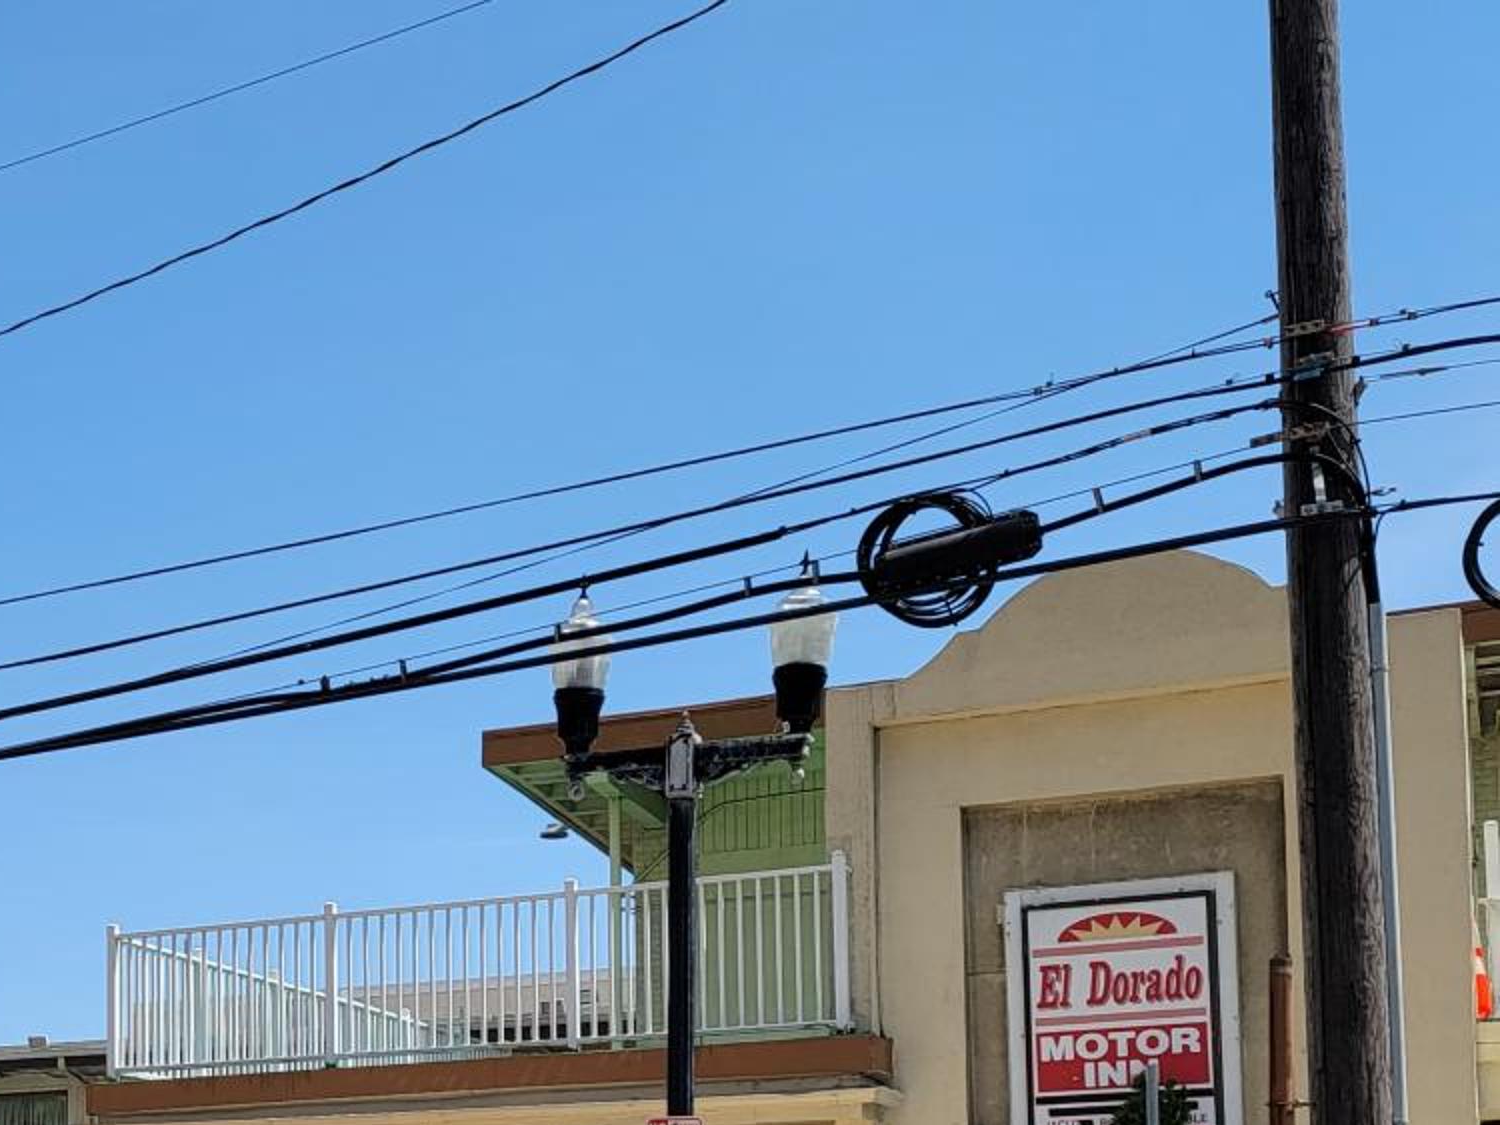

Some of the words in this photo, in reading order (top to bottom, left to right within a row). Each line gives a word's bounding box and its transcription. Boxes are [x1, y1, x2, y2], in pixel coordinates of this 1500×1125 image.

[1037, 964, 1071, 1010] El
[1086, 954, 1203, 1007] Dorado
[1039, 1027, 1201, 1063] MOTOR
